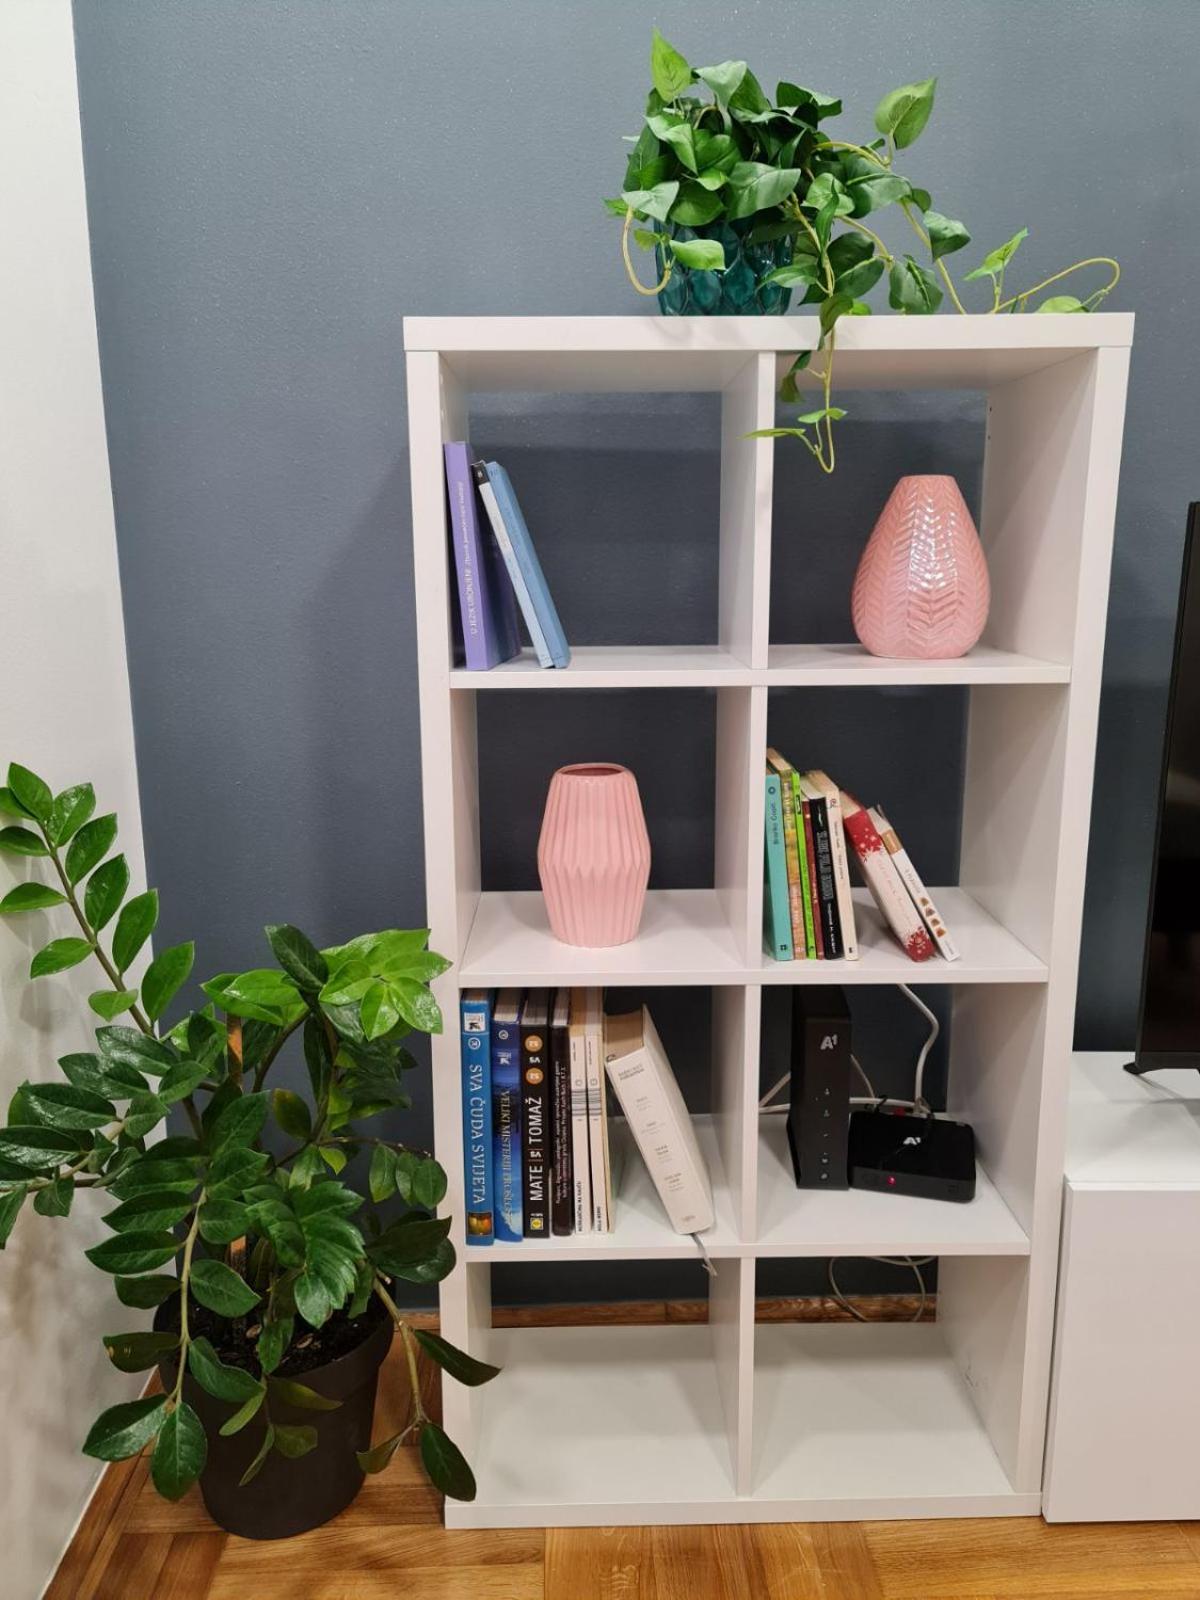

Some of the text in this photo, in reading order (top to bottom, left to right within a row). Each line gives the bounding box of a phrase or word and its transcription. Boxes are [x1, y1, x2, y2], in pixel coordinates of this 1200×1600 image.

[820, 1034, 838, 1050] A1
[500, 1090, 511, 1123] VELIKI
[525, 1097, 543, 1144] TOMAŽ
[469, 1064, 486, 1204] SVA ČUDA SVIJETA
[903, 1137, 921, 1145] A1
[529, 1165, 543, 1201] MATE
